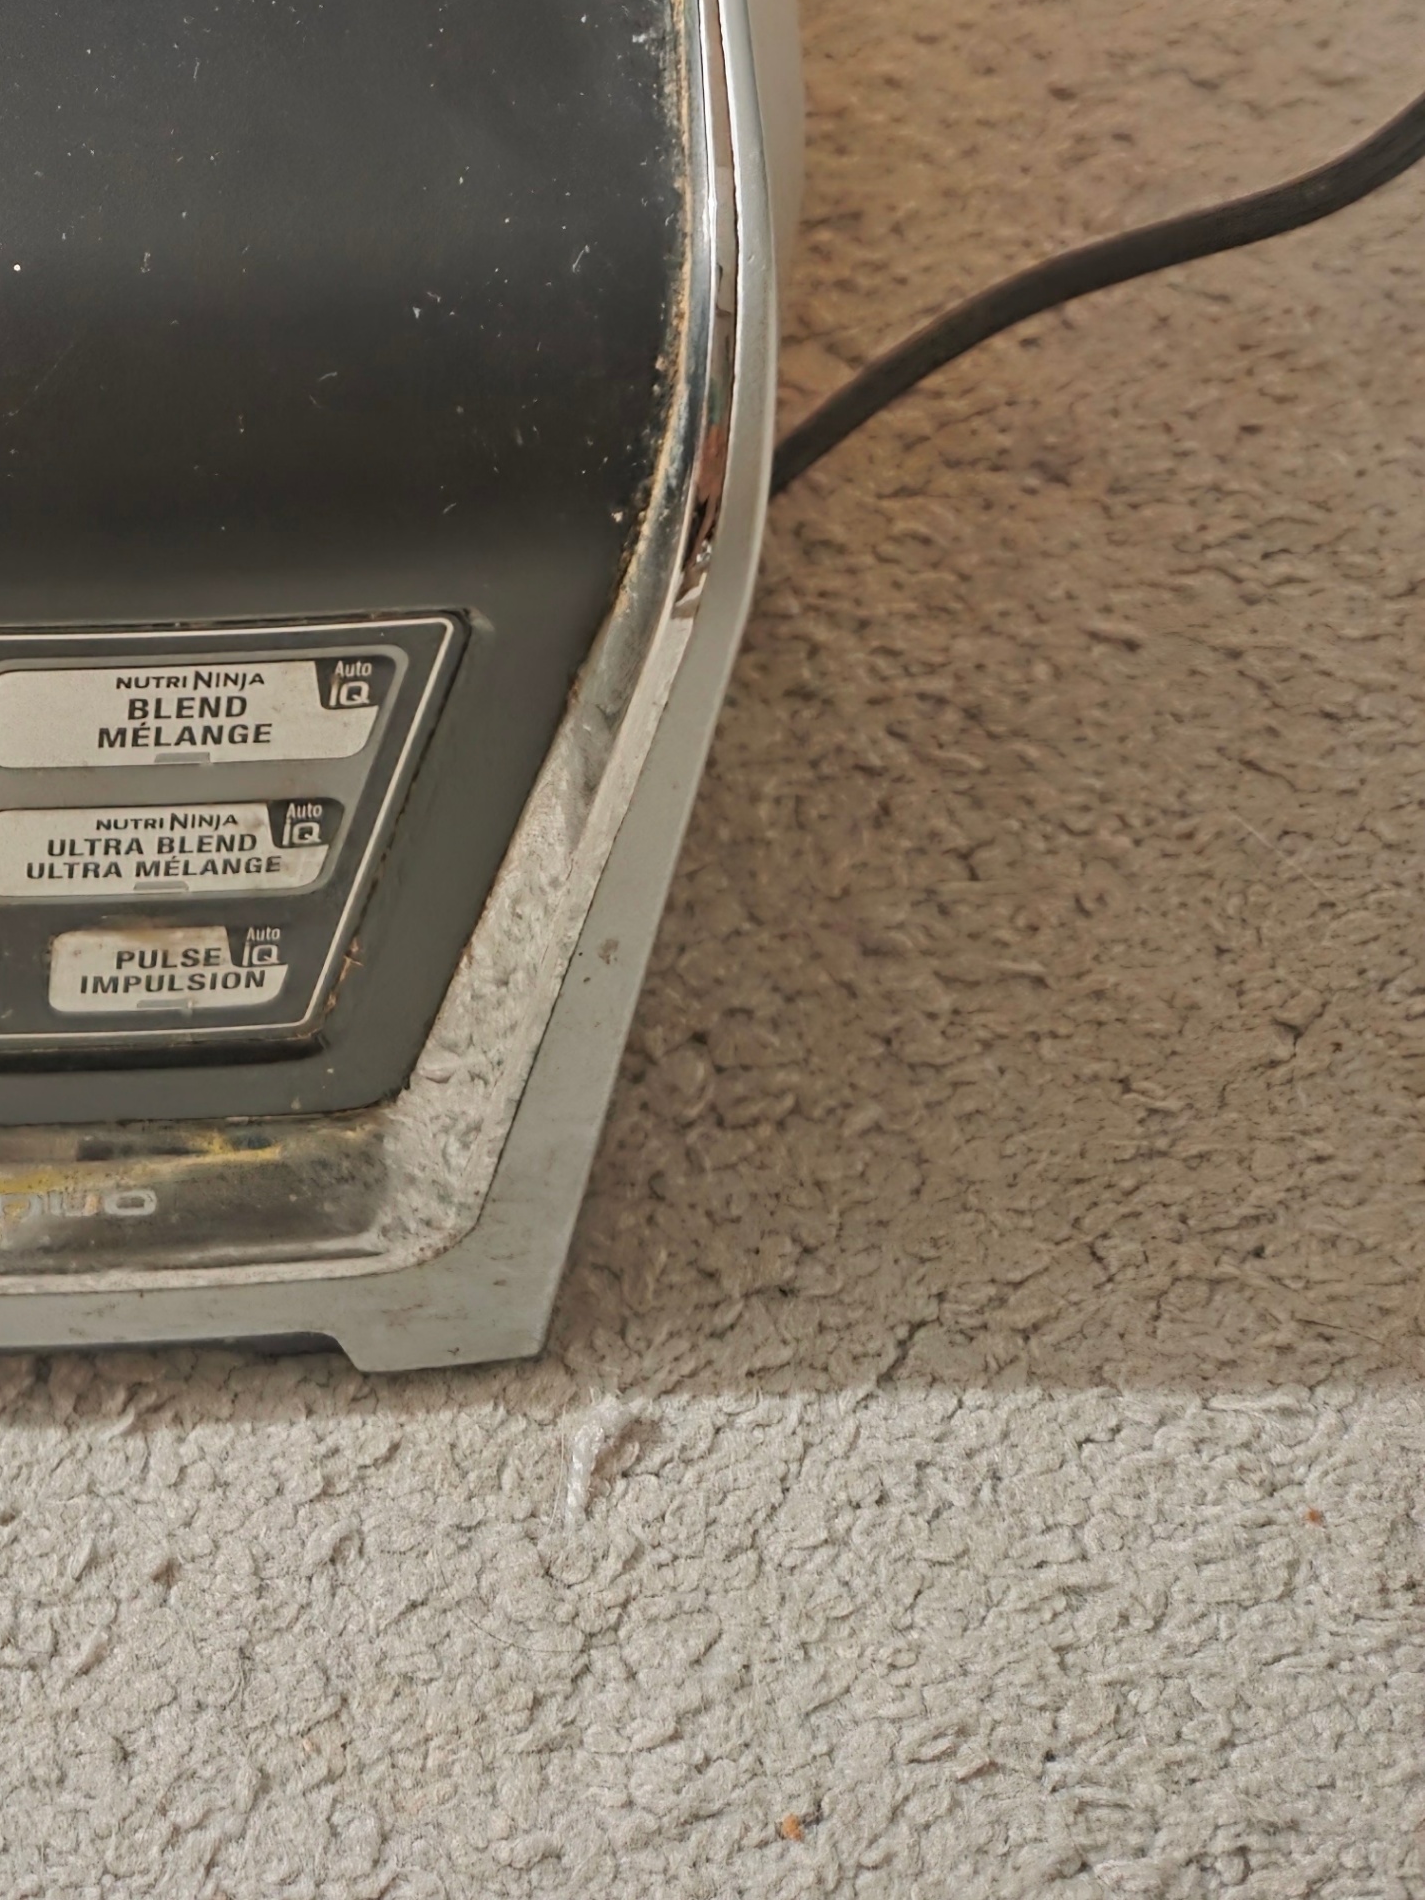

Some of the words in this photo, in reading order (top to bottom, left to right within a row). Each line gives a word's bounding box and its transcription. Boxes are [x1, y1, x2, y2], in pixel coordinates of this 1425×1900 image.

[334, 660, 372, 678] Auto
[116, 675, 187, 691] NUTRI
[193, 671, 265, 692] NINJA
[127, 696, 248, 721] BLEND
[97, 722, 273, 749] MÉLANGE
[287, 802, 323, 820] Auto
[96, 817, 164, 832] NUTRI
[170, 813, 237, 831] NINJA
[47, 838, 144, 857] ULTRA
[157, 833, 257, 855] BLEND
[26, 860, 122, 880] ULTRA
[134, 854, 282, 878] MÉLANGE
[247, 926, 281, 943] Auto
[116, 948, 222, 970] PULSE
[79, 969, 266, 994] IMPULSION
